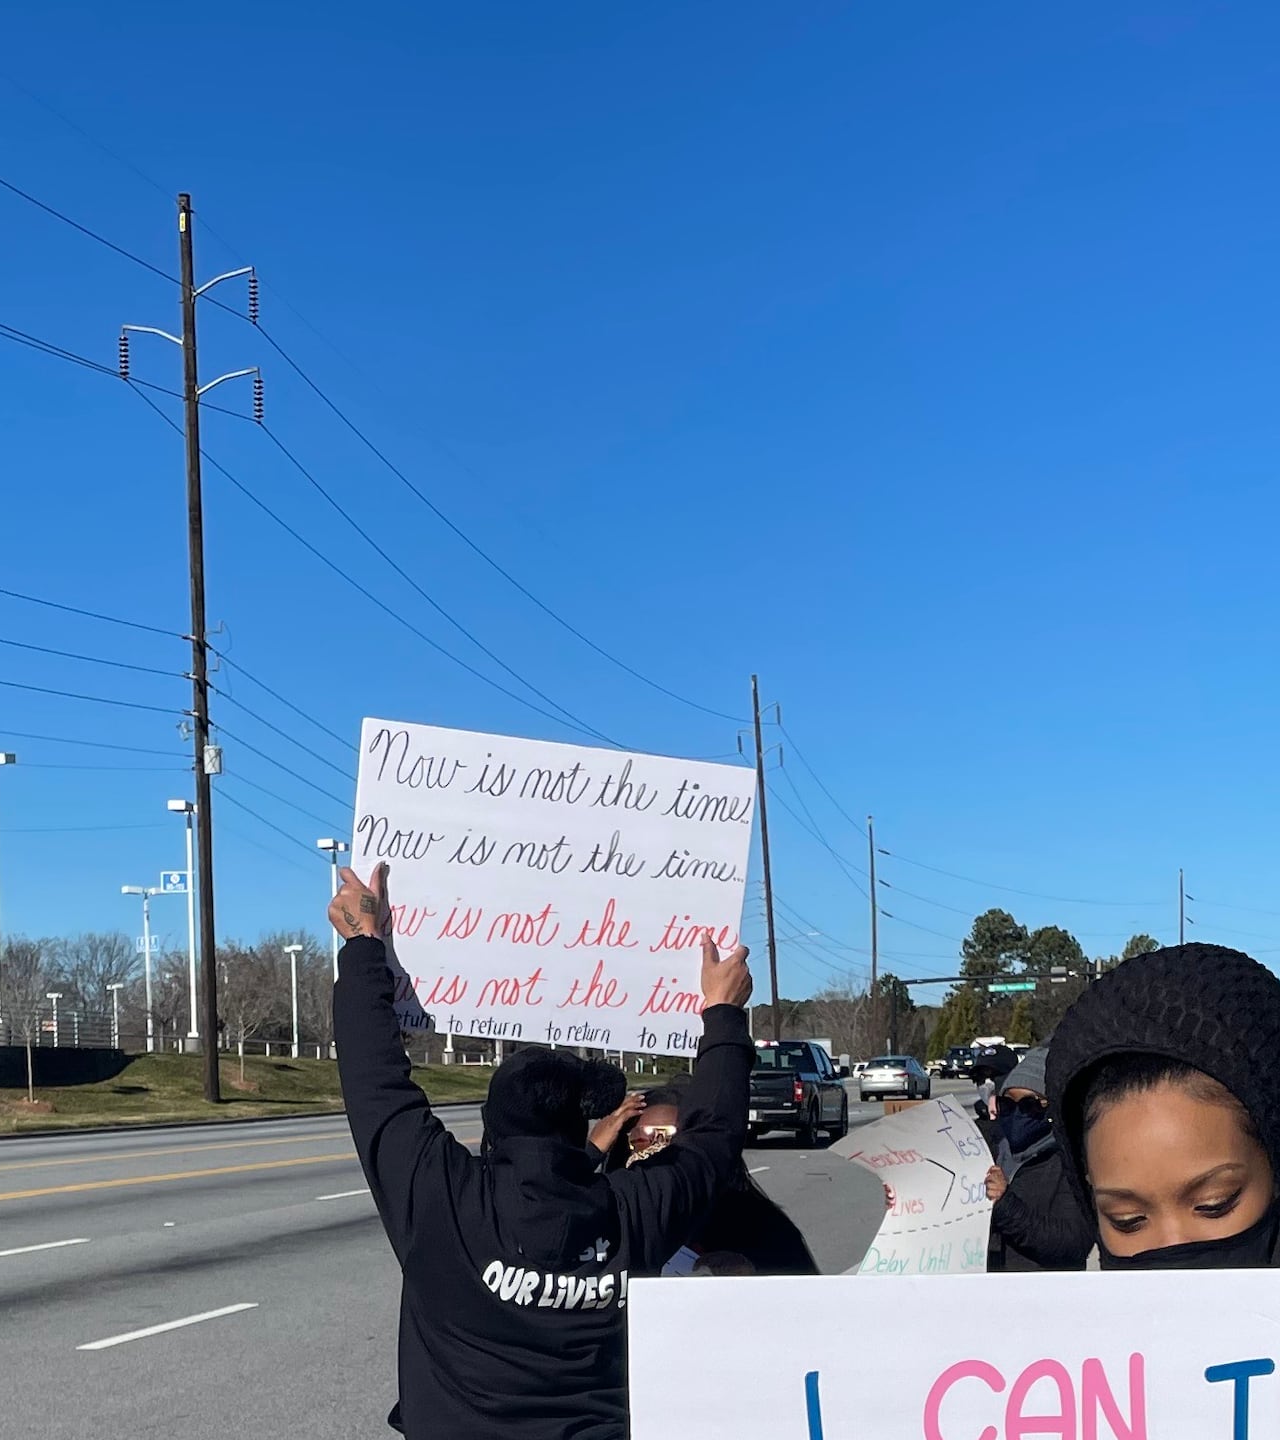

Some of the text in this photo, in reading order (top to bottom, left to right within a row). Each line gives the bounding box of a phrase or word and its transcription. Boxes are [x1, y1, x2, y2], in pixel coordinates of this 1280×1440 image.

[369, 729, 468, 789] Now
[464, 752, 517, 797] is
[519, 762, 591, 804] not
[589, 758, 659, 812] the
[357, 813, 446, 860] Now
[447, 828, 497, 866] is
[501, 835, 573, 874] not
[578, 829, 646, 878] the
[382, 904, 437, 937] ow
[436, 897, 483, 940] is
[486, 903, 561, 947] not
[563, 898, 639, 949] the
[423, 966, 469, 1008] is
[475, 967, 548, 1008] not
[556, 959, 628, 1008] the
[447, 1014, 463, 1034] to
[470, 1016, 523, 1038] return
[544, 1021, 562, 1042] to
[566, 1021, 612, 1044] return
[637, 1026, 657, 1048] to
[666, 1028, 699, 1050] retu
[482, 1260, 541, 1306] OUR
